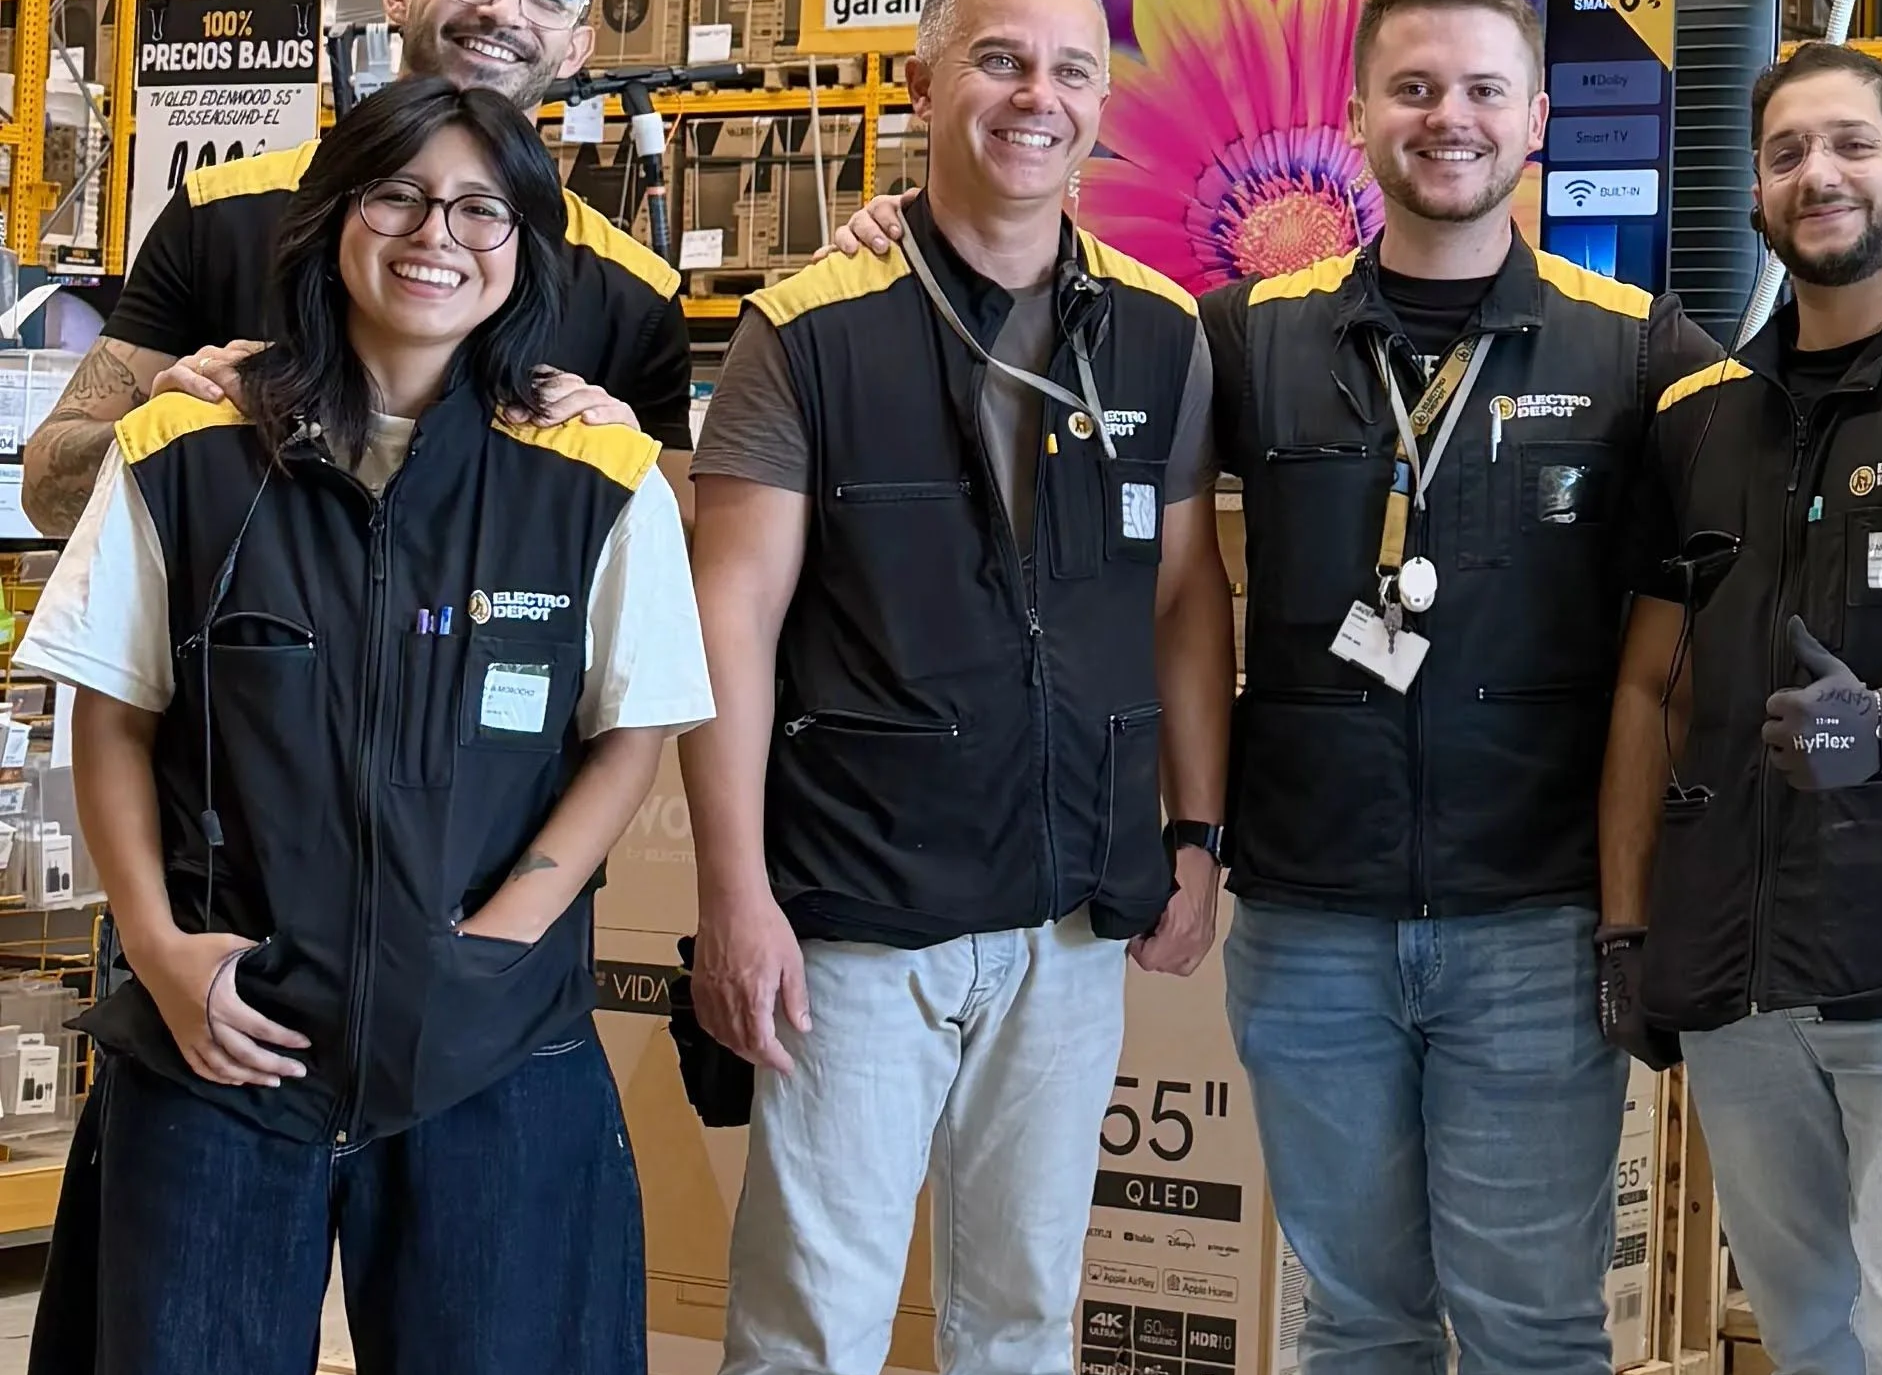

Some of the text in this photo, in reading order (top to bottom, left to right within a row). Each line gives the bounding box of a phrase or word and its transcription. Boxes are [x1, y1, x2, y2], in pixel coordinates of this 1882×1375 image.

[203, 10, 253, 38] 100%
[141, 39, 314, 72] PRECIOS BAJOS
[150, 91, 166, 107] TV
[164, 90, 198, 107] QLED
[200, 89, 272, 106] EDENWOOD
[1576, 130, 1629, 144] Smart TV
[1517, 394, 1591, 407] ELECTRO
[1517, 406, 1576, 418] DEPOT
[492, 591, 571, 609] ELECTRO
[493, 605, 551, 621] DEPOT
[1125, 1179, 1199, 1209] QLED
[1103, 1273, 1155, 1290] Apple AirPlay
[1182, 1282, 1234, 1298] Apple Home
[1090, 1312, 1123, 1328] 4K
[1189, 1331, 1232, 1351] HDR10
